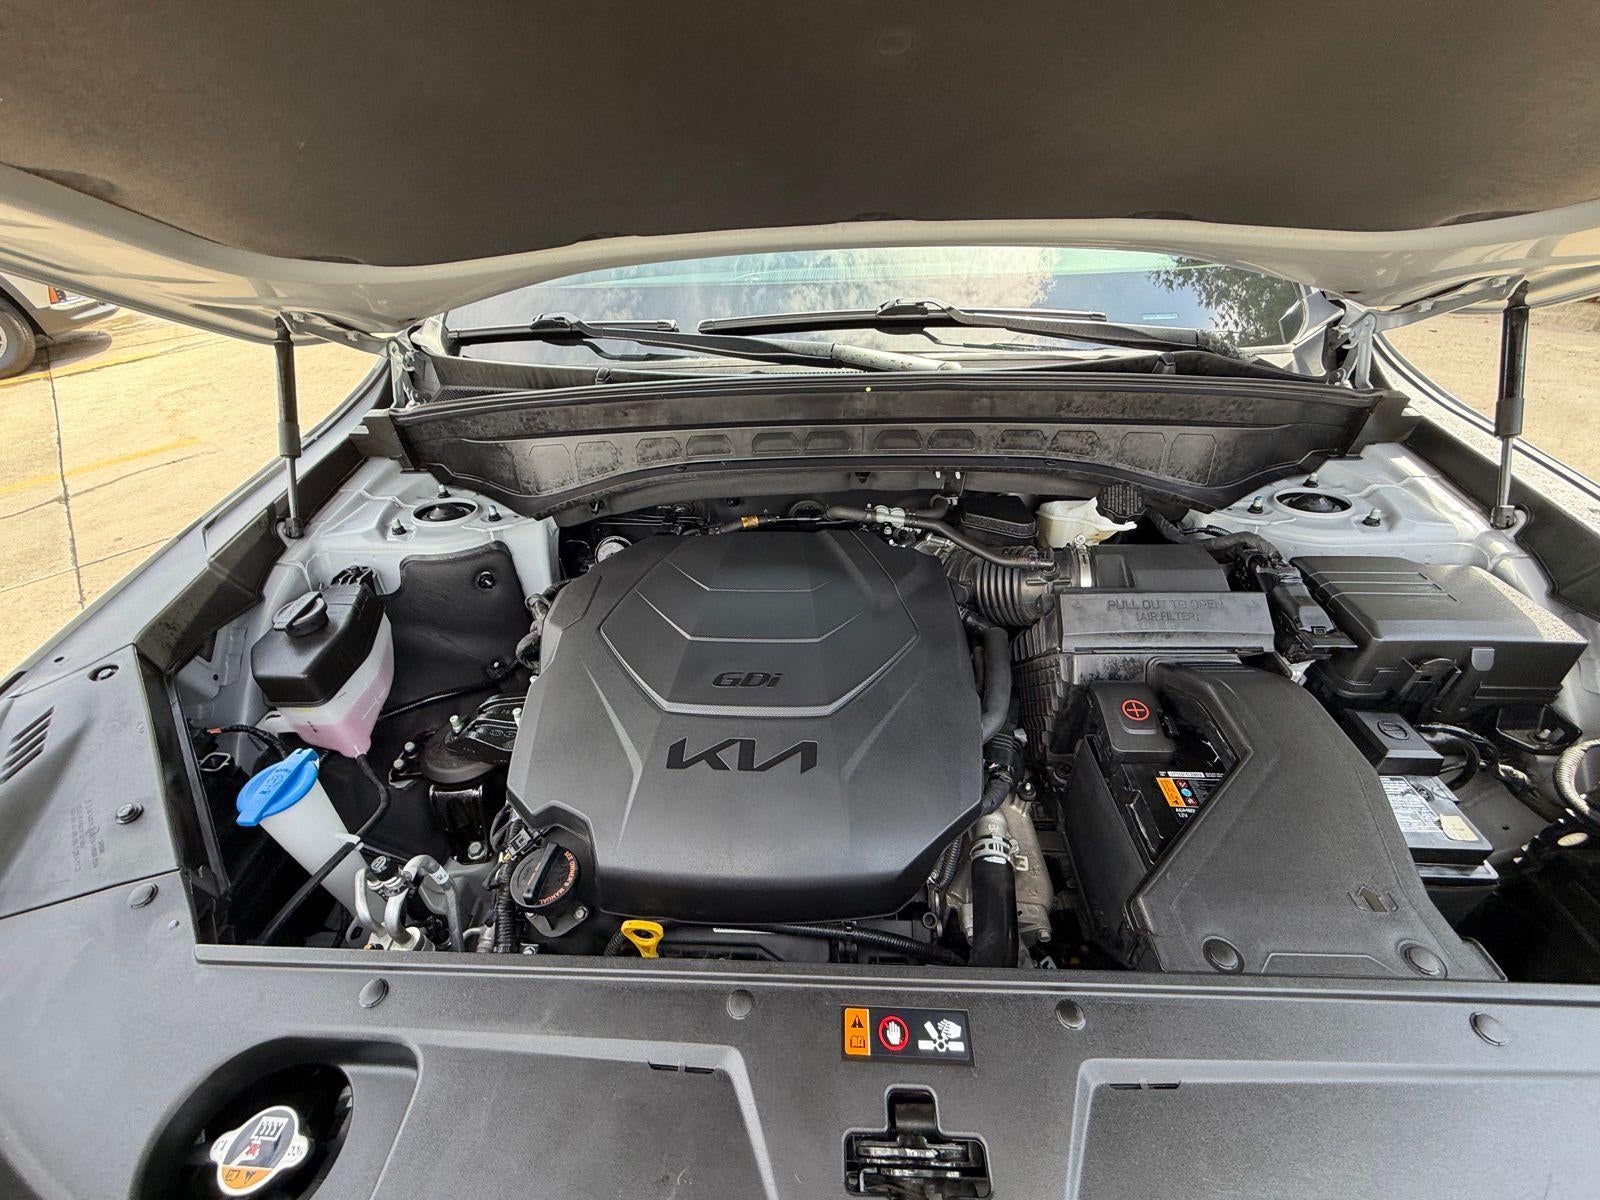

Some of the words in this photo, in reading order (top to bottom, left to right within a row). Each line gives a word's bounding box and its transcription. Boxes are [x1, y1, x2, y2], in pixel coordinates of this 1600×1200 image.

[1107, 599, 1139, 610] PULL
[1142, 599, 1167, 610] OUT
[1171, 600, 1188, 610] TO
[1192, 600, 1224, 610] OPEN
[712, 672, 783, 688] GDi
[666, 737, 819, 775] KIA
[539, 887, 565, 905] MANUAL
